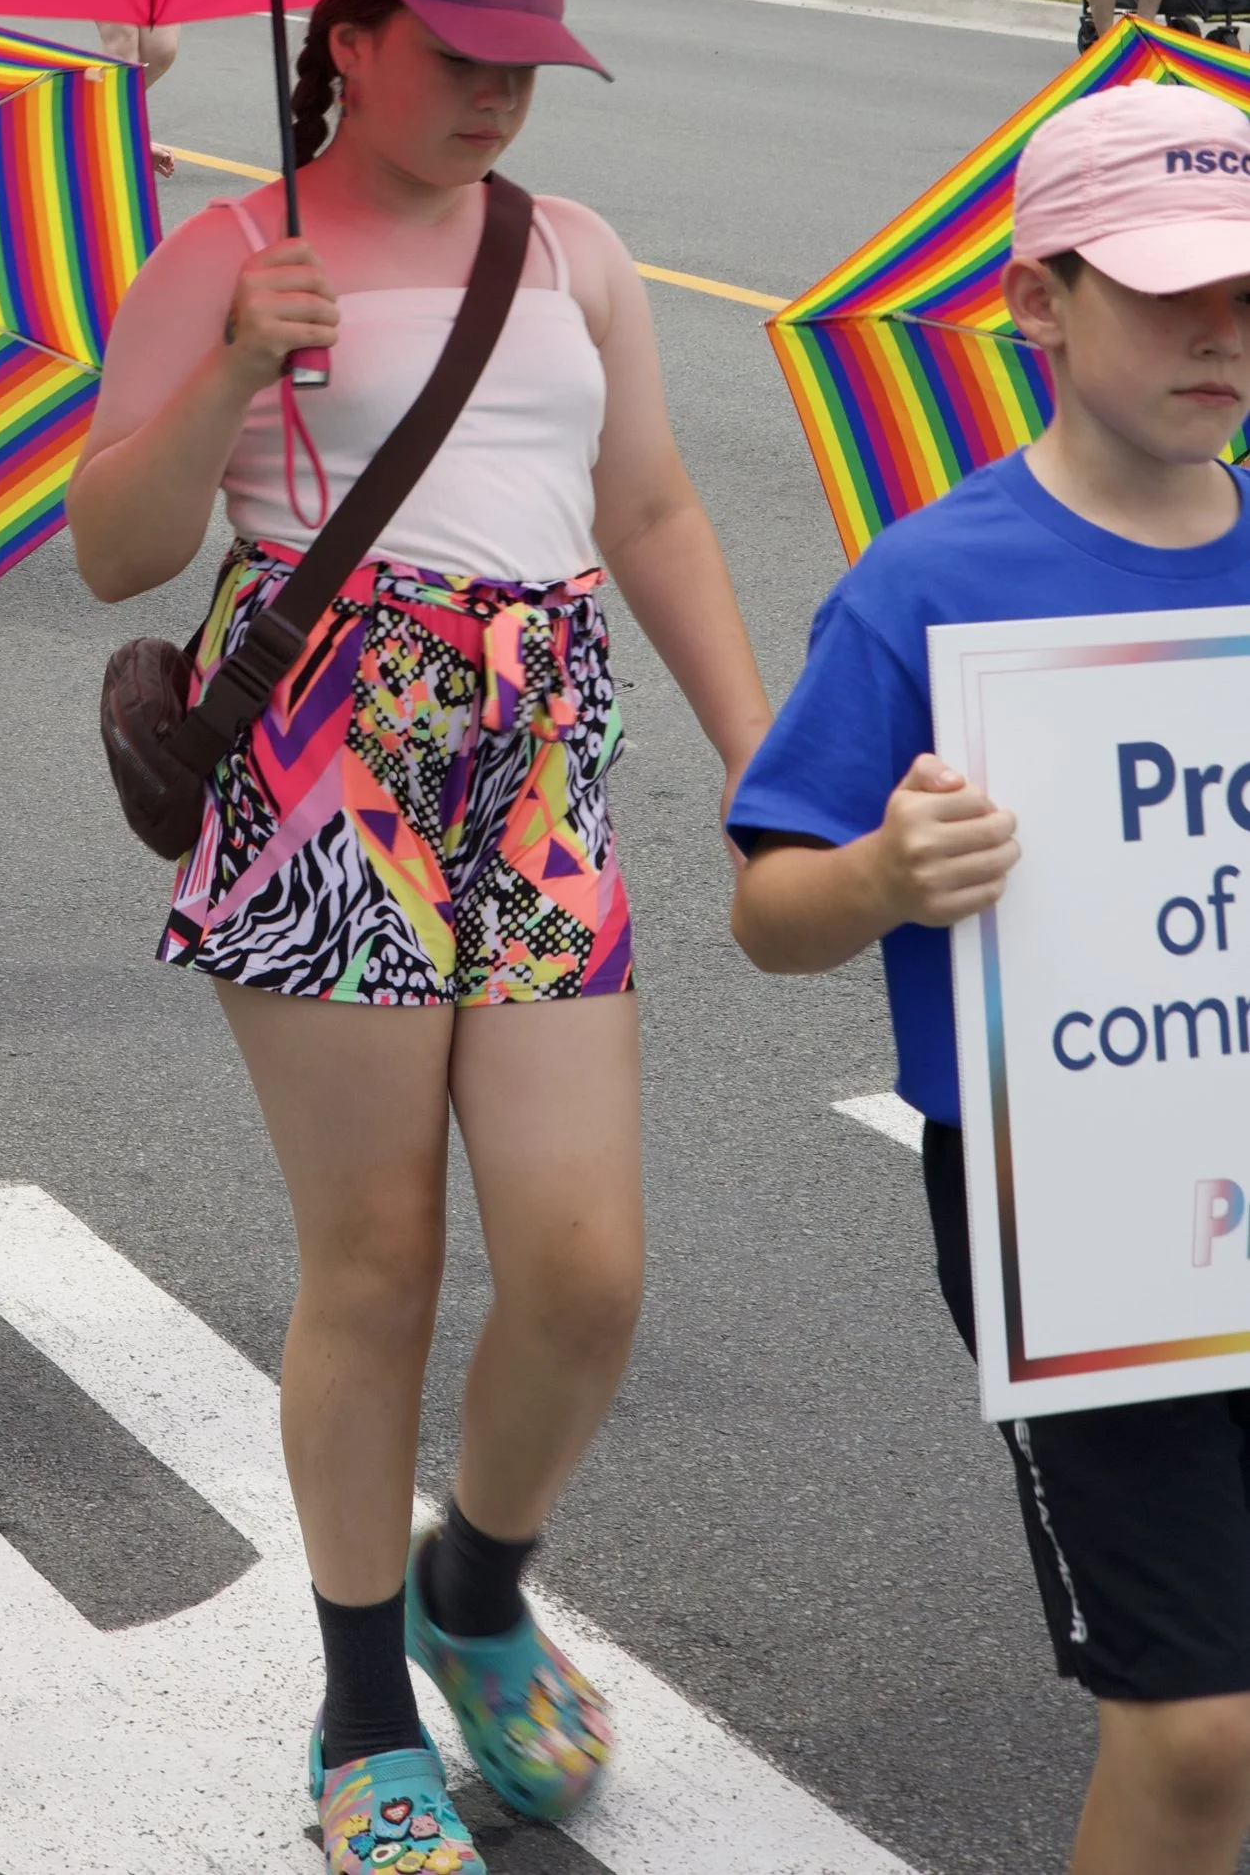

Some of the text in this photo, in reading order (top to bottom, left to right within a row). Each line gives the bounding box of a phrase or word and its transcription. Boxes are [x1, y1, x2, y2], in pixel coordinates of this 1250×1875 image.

[1156, 864, 1241, 956] of
[1052, 995, 1250, 1072] com
[1192, 1177, 1250, 1269] P
